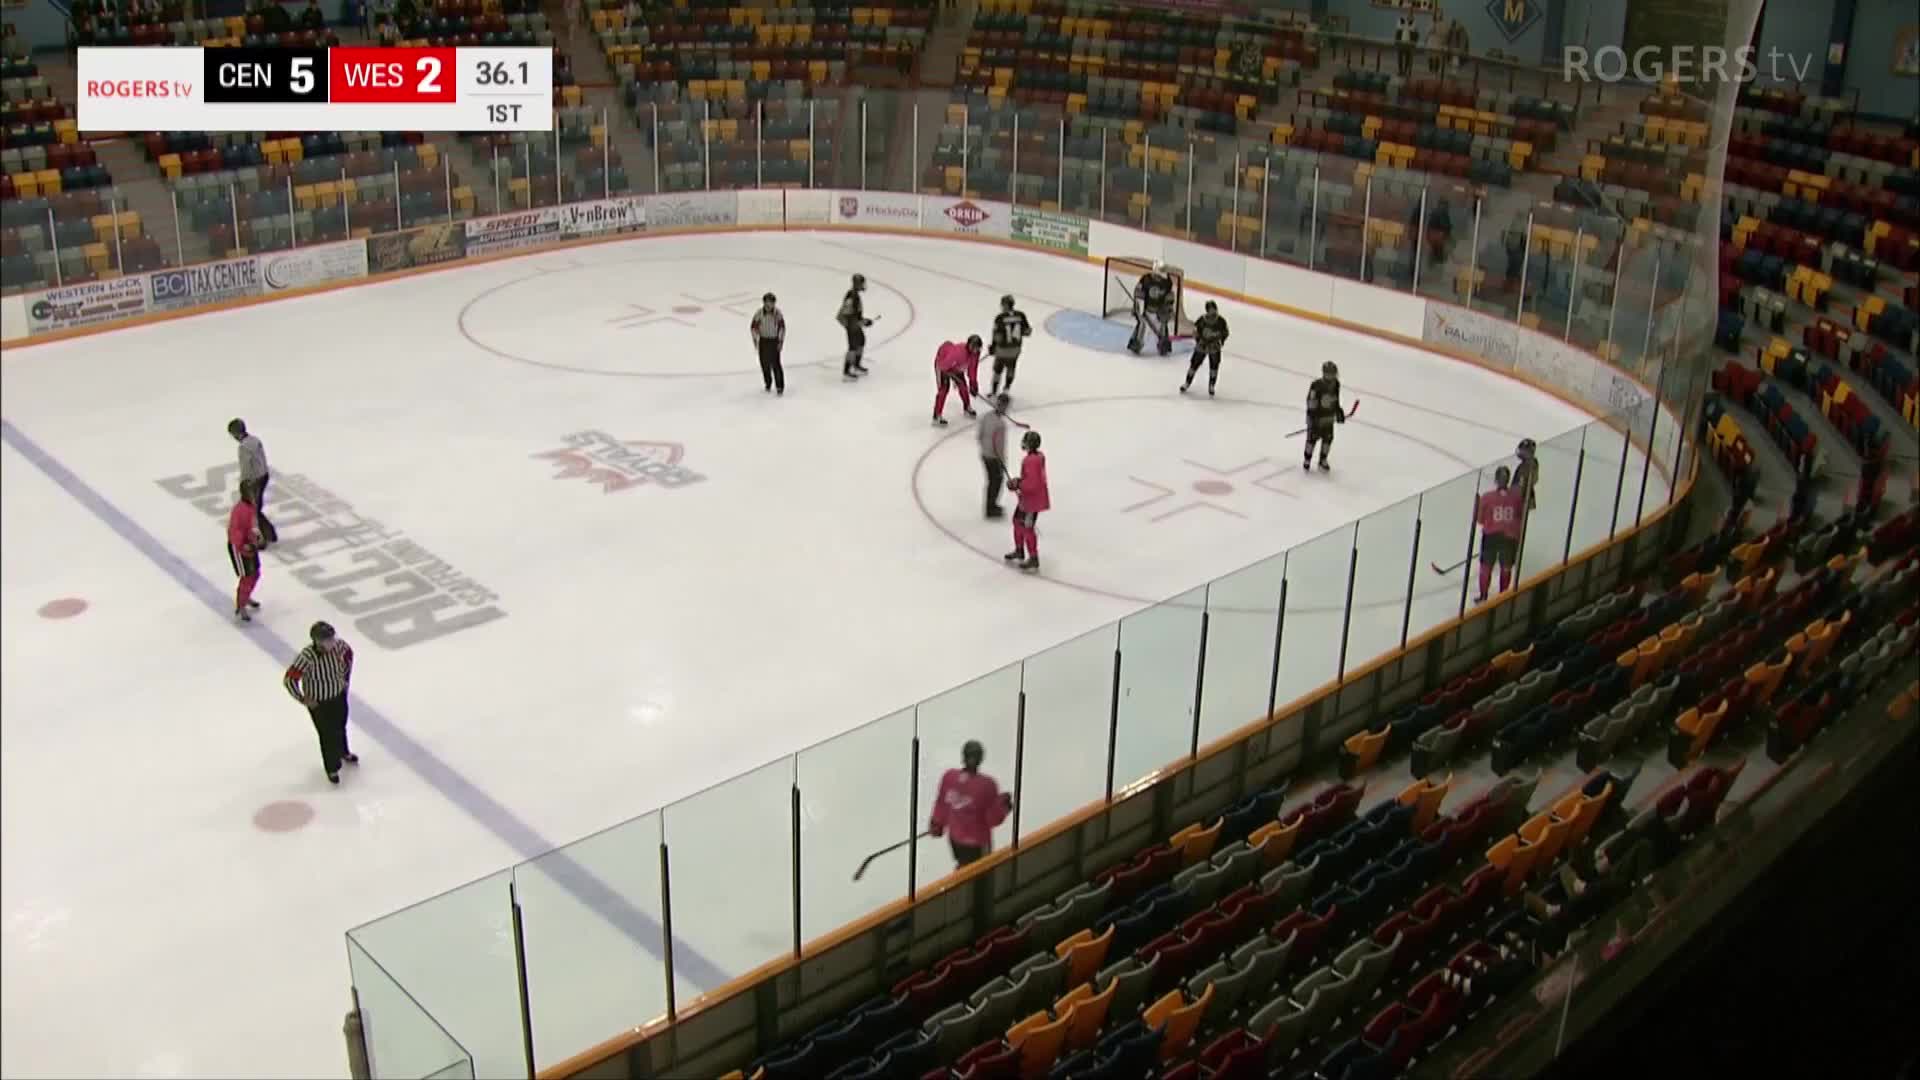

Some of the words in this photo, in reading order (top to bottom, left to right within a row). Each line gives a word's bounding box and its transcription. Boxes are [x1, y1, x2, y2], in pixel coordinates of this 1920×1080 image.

[949, 207, 984, 221] ORKIN
[191, 265, 213, 295] TAX
[215, 260, 257, 291] CENTRE
[47, 284, 104, 301] WESTERN
